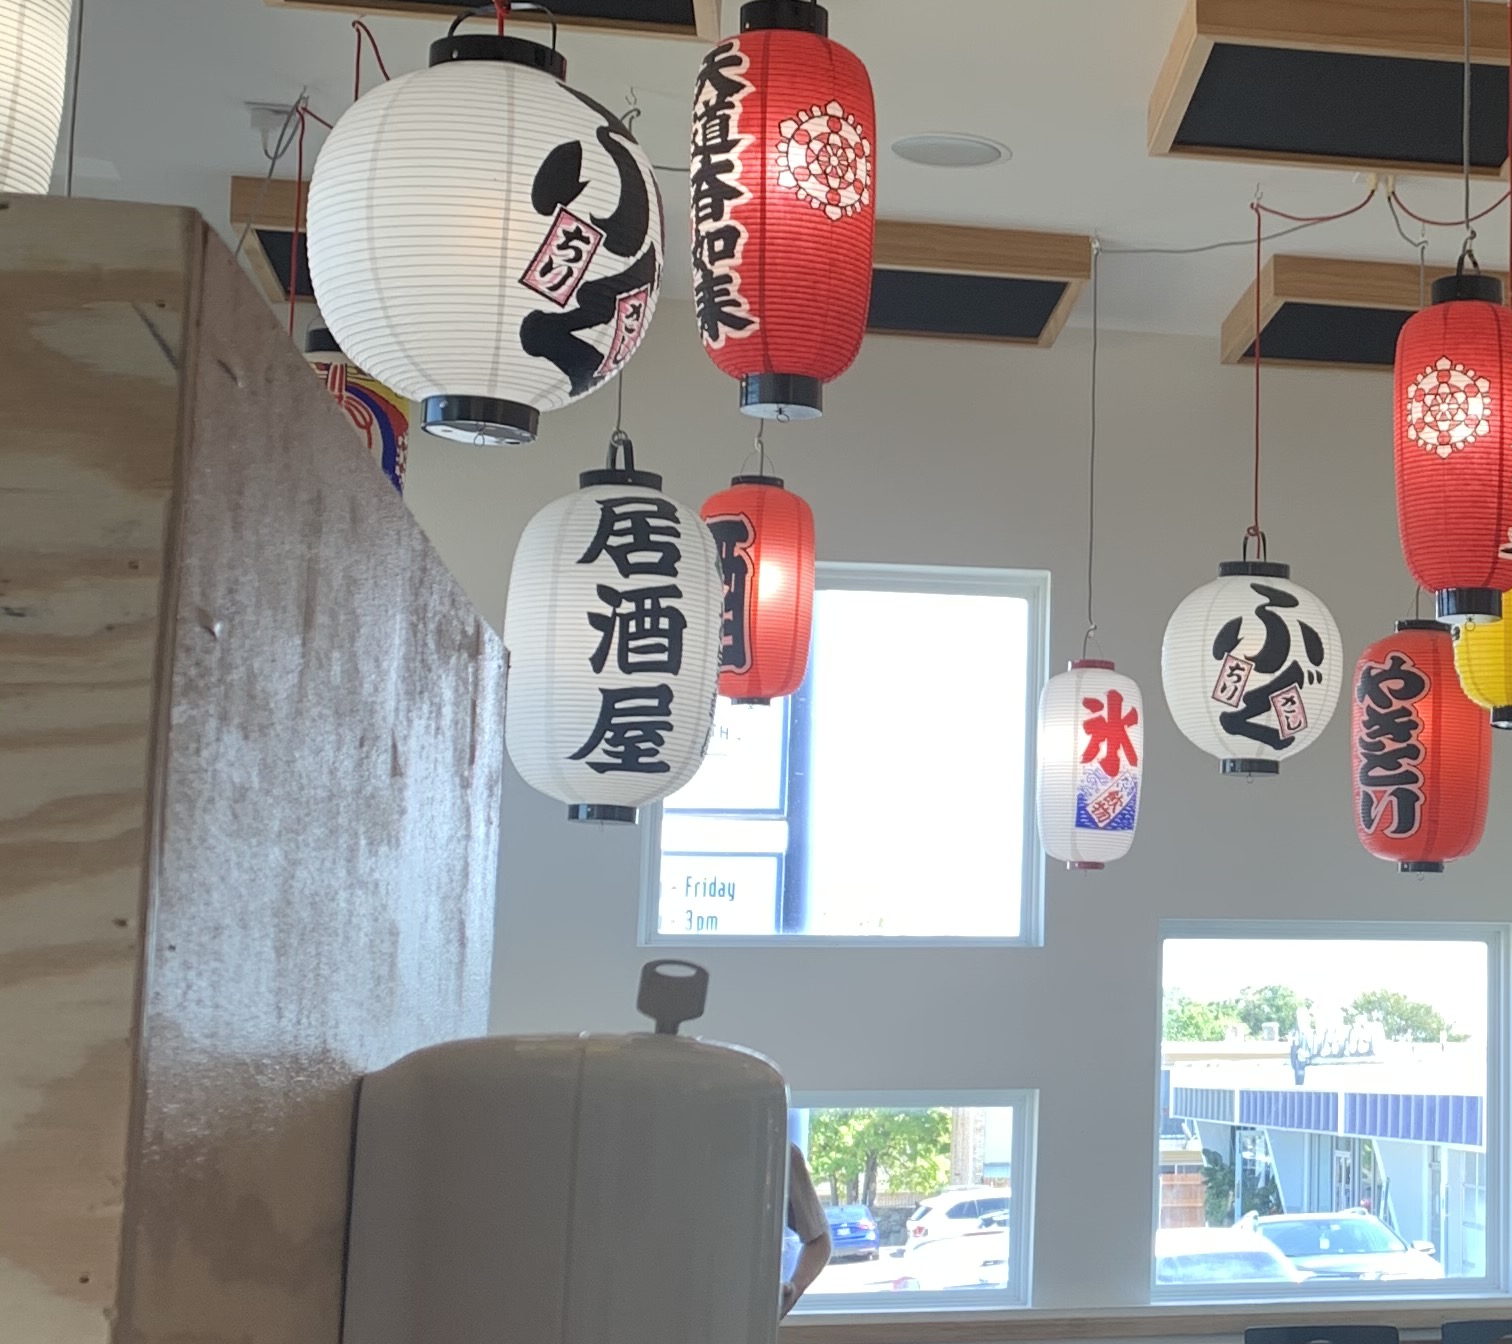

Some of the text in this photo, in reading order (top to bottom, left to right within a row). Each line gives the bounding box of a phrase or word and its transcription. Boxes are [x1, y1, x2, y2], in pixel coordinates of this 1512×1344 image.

[540, 225, 591, 292] ちり
[568, 496, 687, 774] 居酒屋
[1213, 584, 1325, 750] ふぐ
[1220, 662, 1245, 701] ちり
[1281, 695, 1302, 731] さし
[1080, 689, 1138, 778] 氷
[1357, 652, 1428, 837] やきとり
[684, 876, 736, 901] Friday
